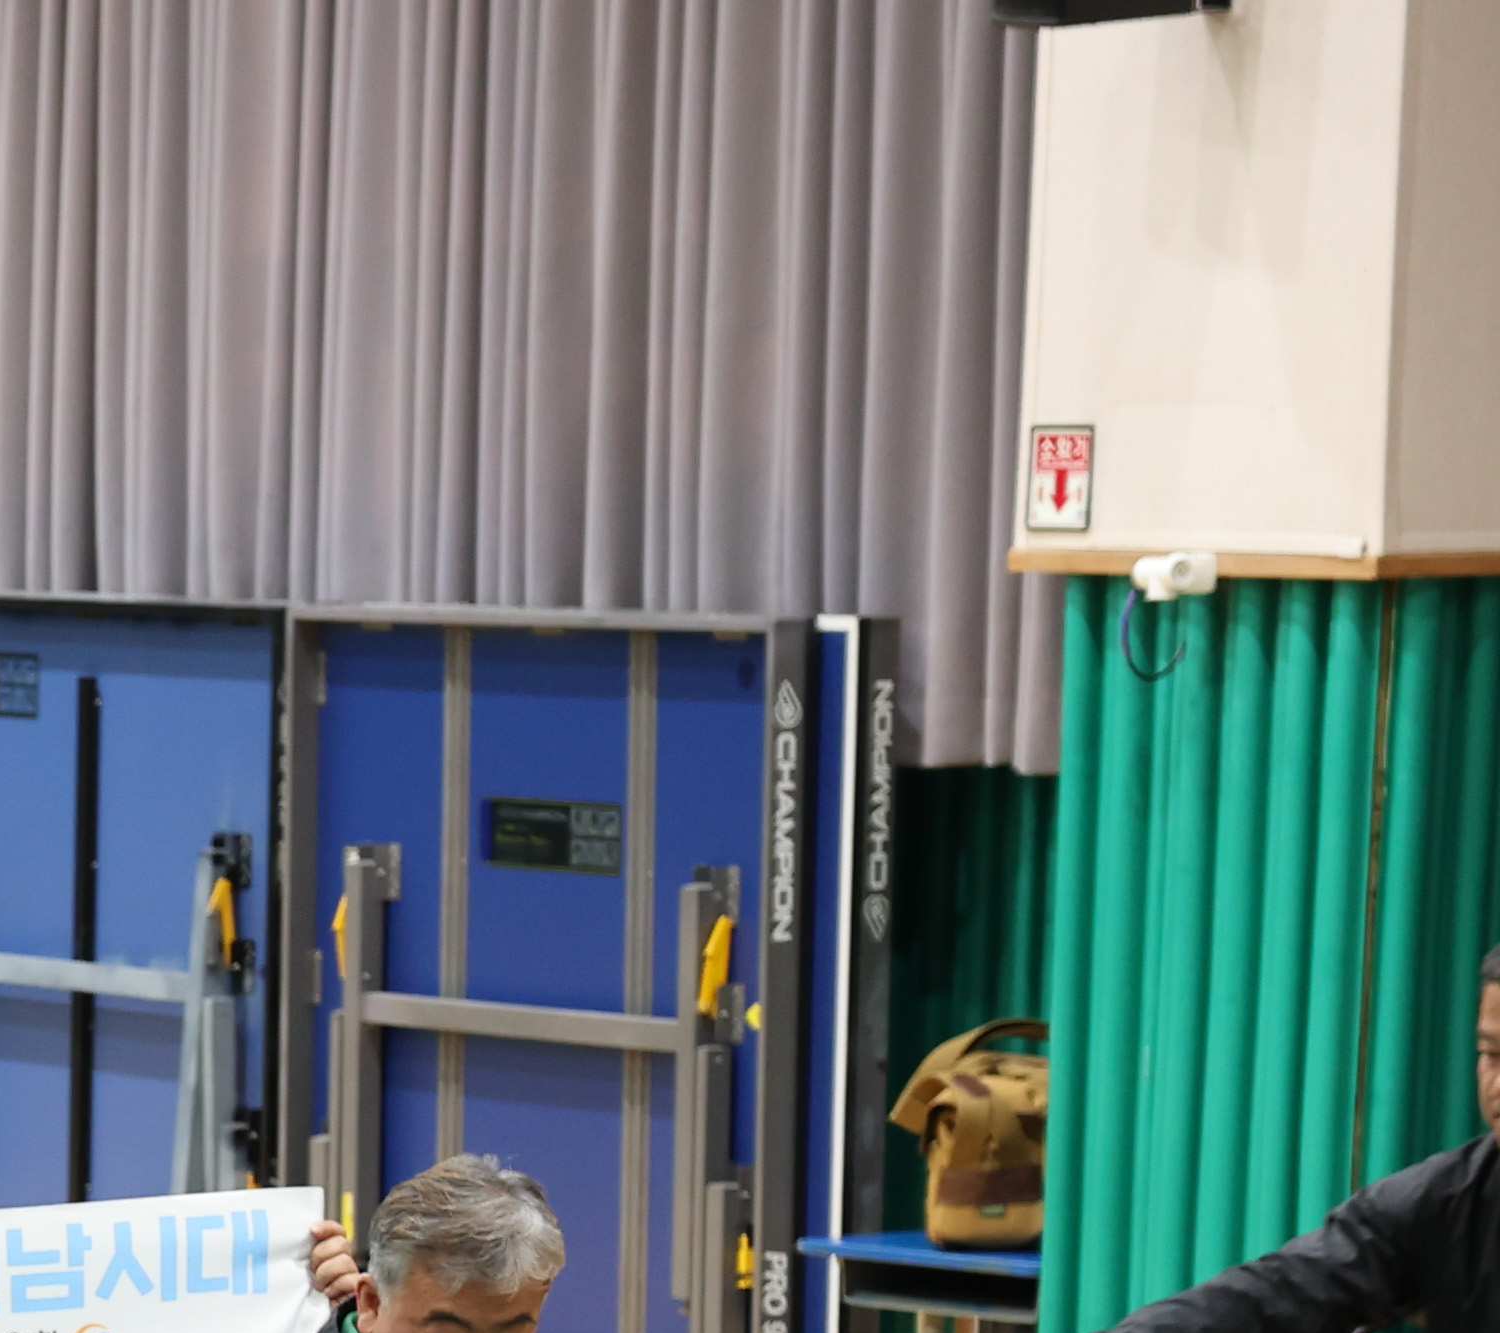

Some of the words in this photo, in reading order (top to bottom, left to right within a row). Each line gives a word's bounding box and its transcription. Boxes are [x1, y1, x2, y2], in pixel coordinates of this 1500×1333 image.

[772, 731, 798, 943] CHAMPION
[869, 679, 895, 890] CHAMPION
[764, 1250, 788, 1316] PRO
